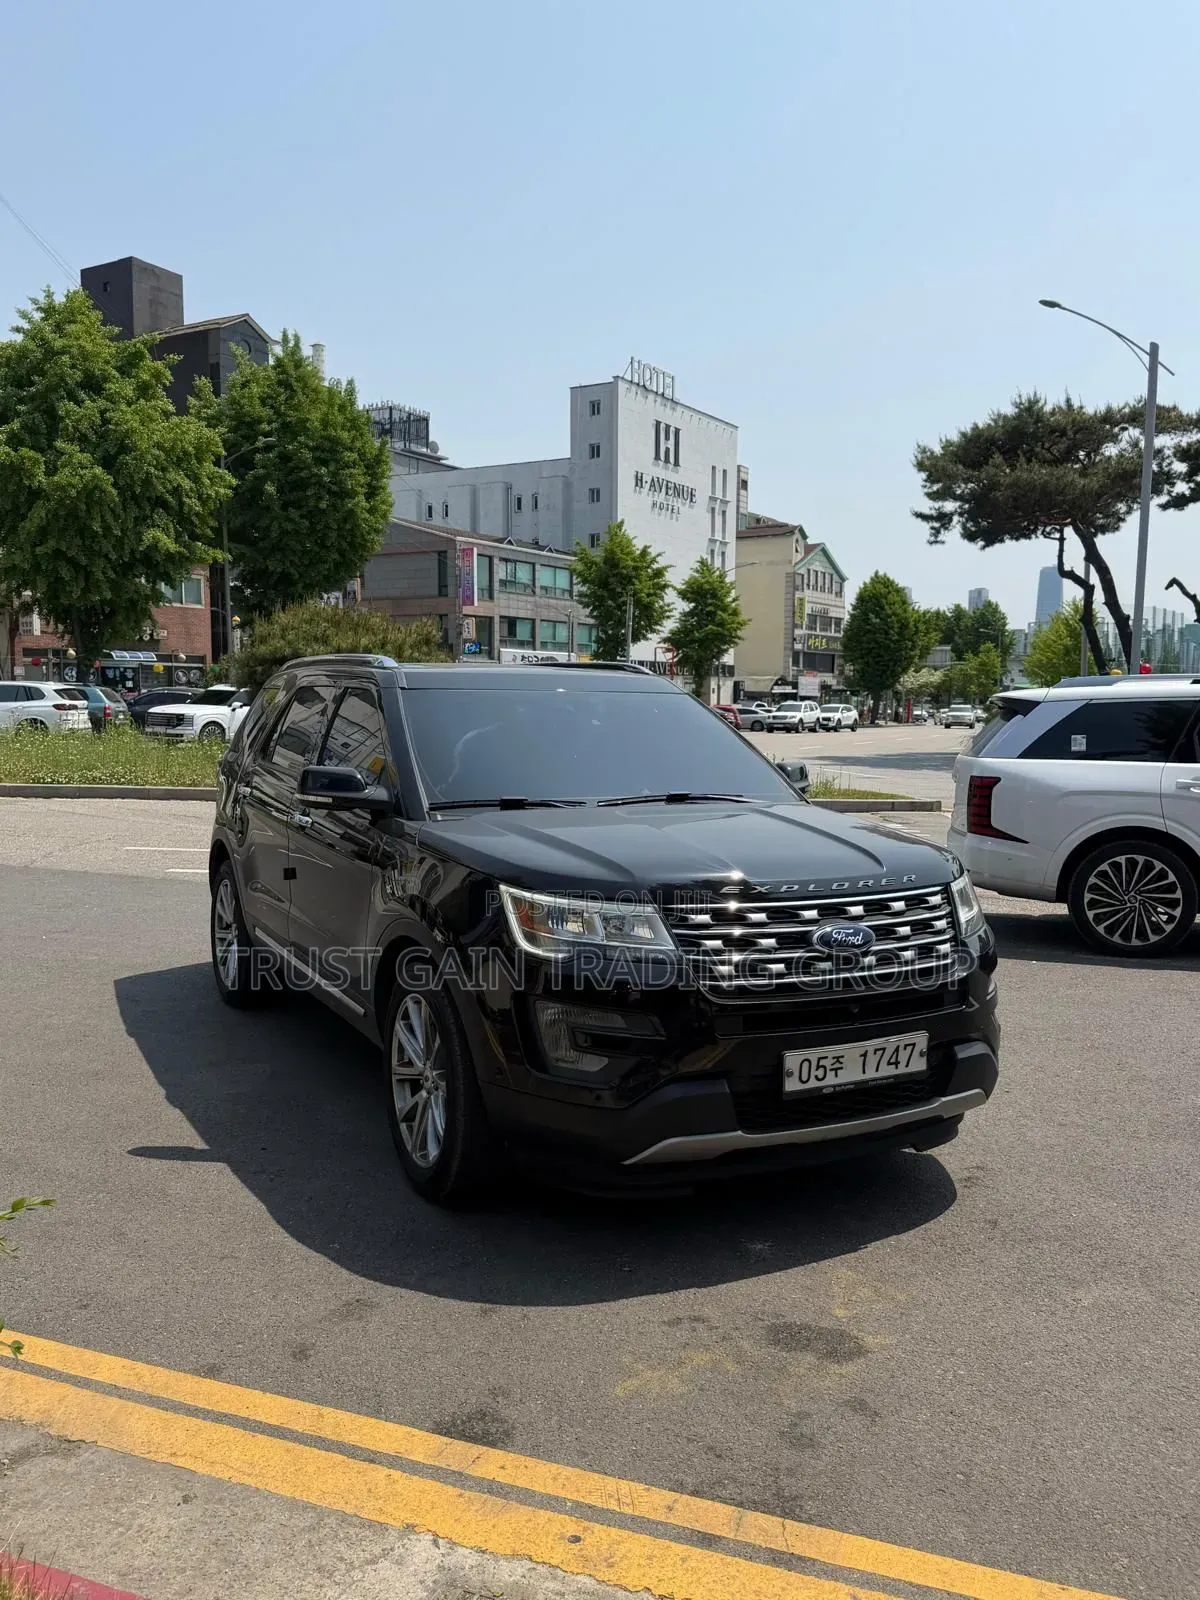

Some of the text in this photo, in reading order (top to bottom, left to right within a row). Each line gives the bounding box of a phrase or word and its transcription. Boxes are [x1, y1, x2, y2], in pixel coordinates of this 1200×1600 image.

[631, 356, 677, 401] HOTEL
[653, 419, 682, 467] H
[652, 500, 681, 515] HOTEL
[719, 874, 917, 894] EXPLORER
[830, 929, 865, 946] Ford
[798, 1043, 917, 1084] 05주 1747
